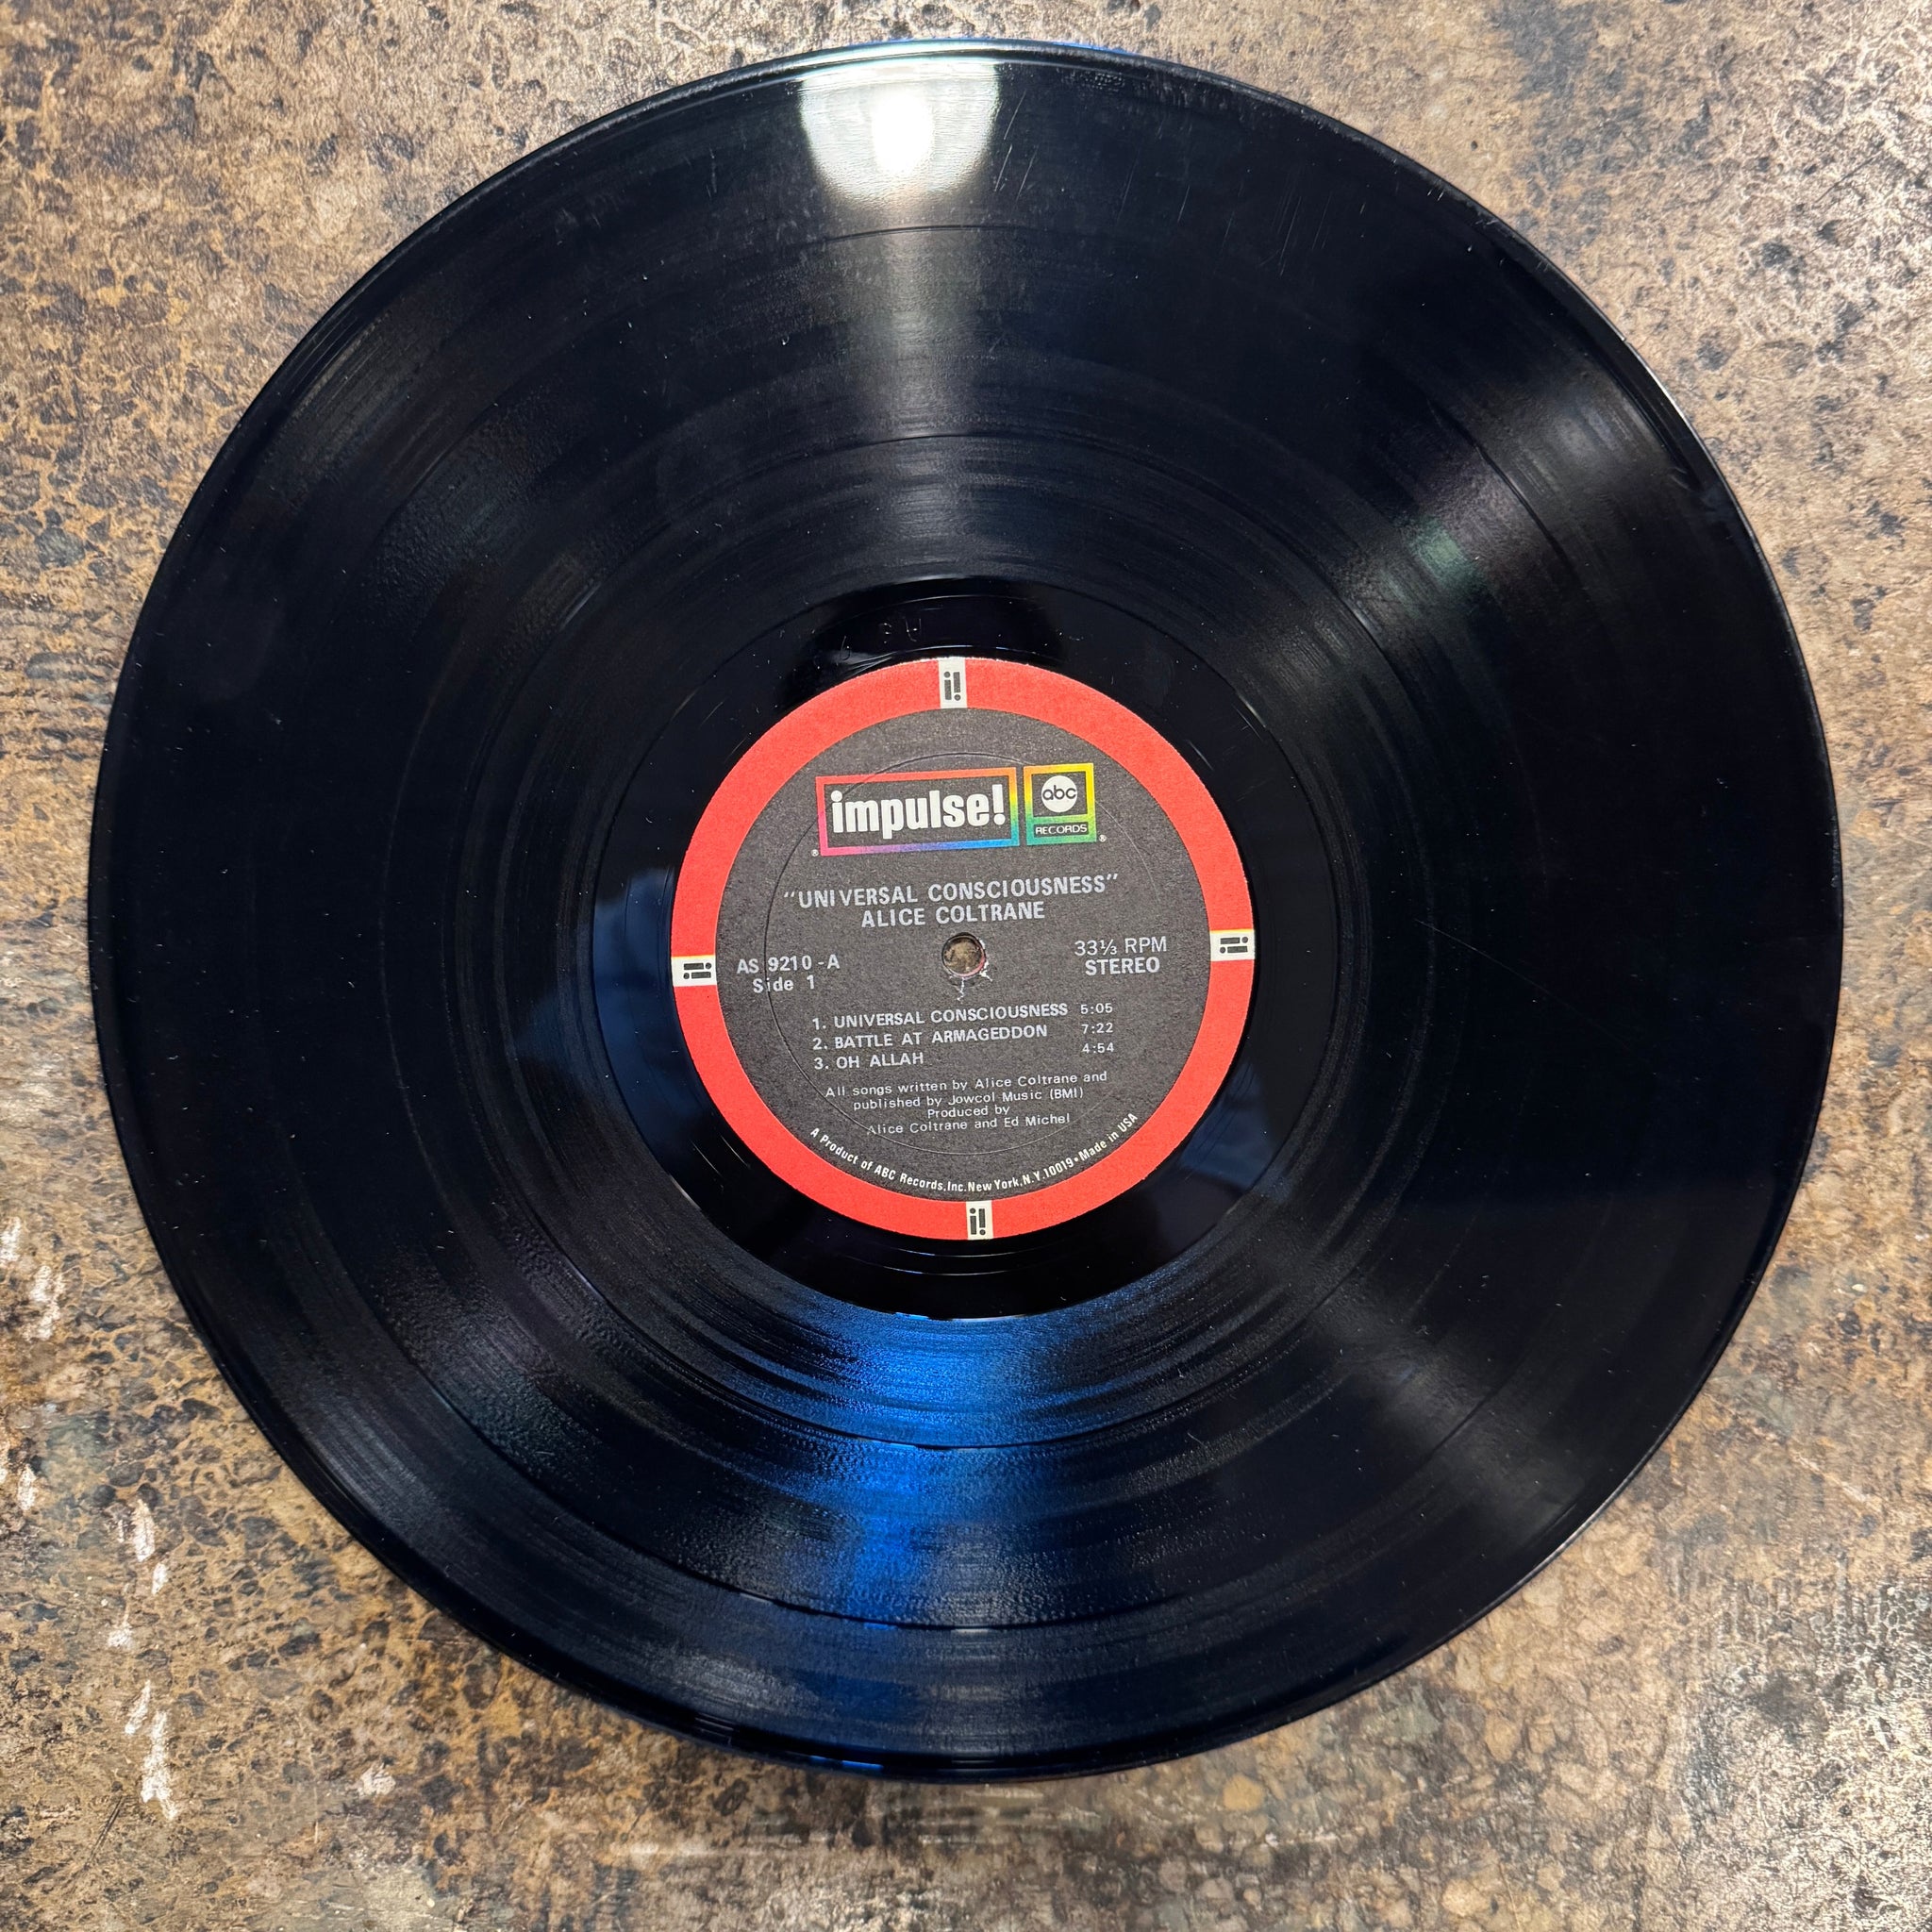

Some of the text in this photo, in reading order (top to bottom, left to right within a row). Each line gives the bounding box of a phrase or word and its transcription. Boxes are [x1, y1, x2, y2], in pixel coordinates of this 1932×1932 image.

[1041, 784, 1077, 802] abc
[831, 784, 1006, 839] impulse!
[1035, 824, 1088, 835] RECORDS
[860, 900, 1045, 927] ALICE COLTRANE
[1124, 936, 1167, 953] RPM
[736, 957, 758, 974] AS
[1084, 958, 1161, 976] STEREO
[752, 974, 815, 994] Side 1
[812, 1003, 1069, 1031] 1. UNIVERSAL CONSCIOUSNESS
[1080, 1003, 1113, 1016] 5:05
[812, 1024, 1048, 1050] 2. BATTLE AT ARMAGEDDON
[1081, 1022, 1114, 1035] 7:22
[1082, 1041, 1115, 1055] 4:54
[814, 1052, 924, 1070] 3. OH ALLAH
[825, 1070, 1108, 1098] All songs written by Alice Coltrane and
[854, 1087, 1084, 1110] published by Jowcol Music (BMI)
[926, 1104, 1010, 1119] Produced by
[866, 1112, 1071, 1136] Alice Coltrane and Ed Michel
[810, 1127, 821, 1138] A
[820, 1134, 859, 1164] Product
[860, 1159, 873, 1171] of
[874, 1165, 896, 1180] ABC
[1078, 1140, 1108, 1161] Made
[1107, 1131, 1119, 1143] in
[1118, 1112, 1139, 1132] USA
